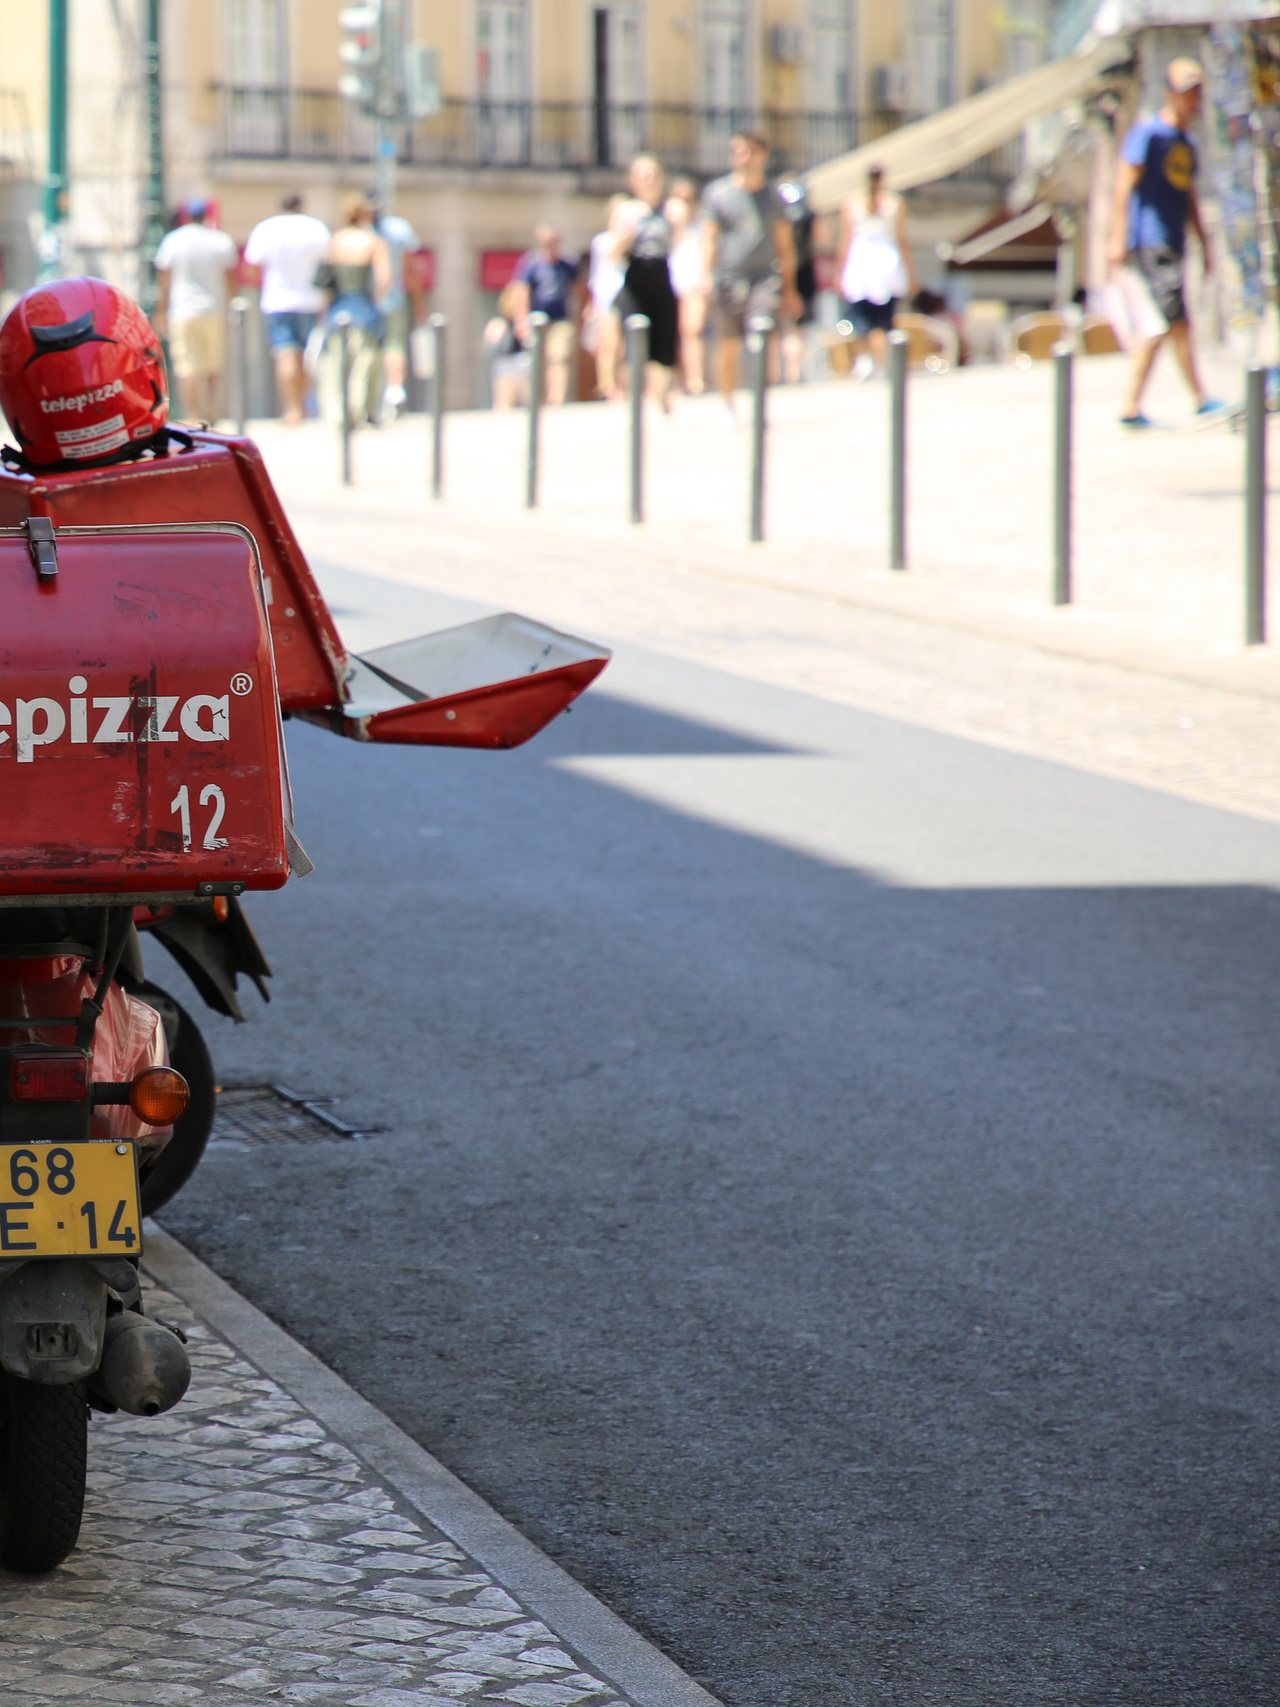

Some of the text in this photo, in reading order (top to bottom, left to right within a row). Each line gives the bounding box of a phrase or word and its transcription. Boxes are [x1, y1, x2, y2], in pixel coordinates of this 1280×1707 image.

[39, 378, 124, 413] telepizza
[170, 783, 229, 853] 12
[9, 1147, 76, 1196] 68
